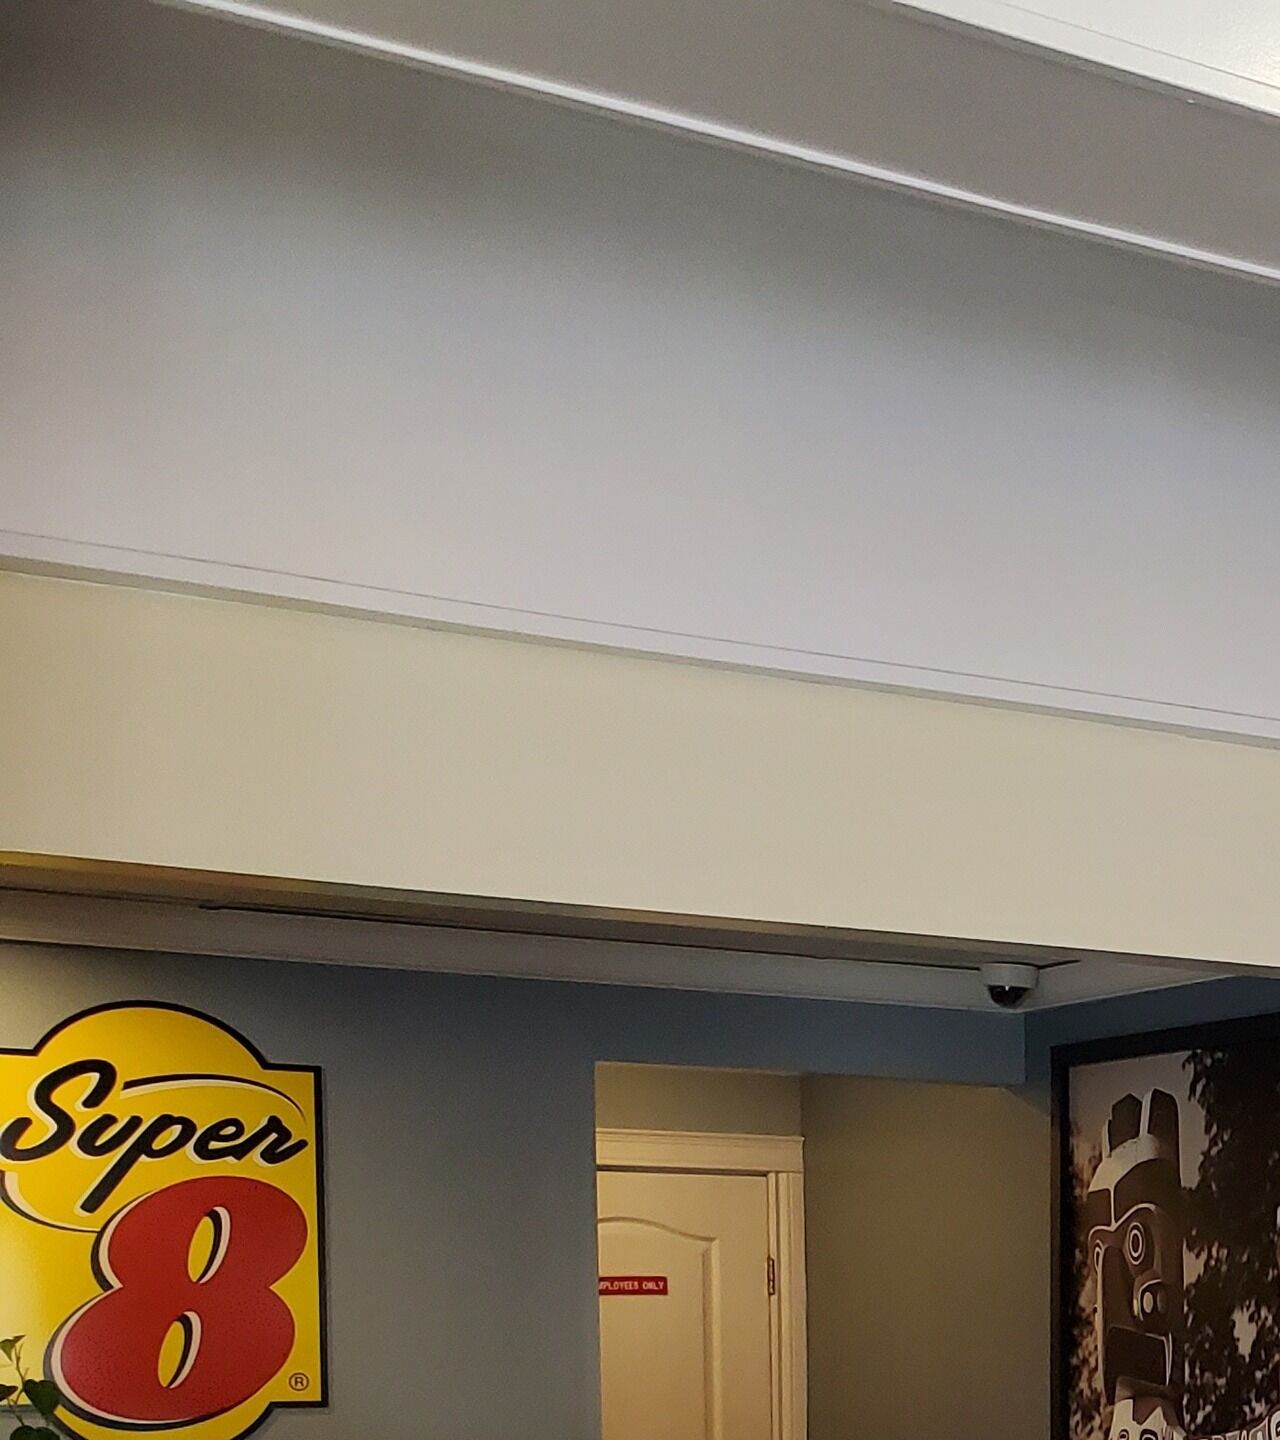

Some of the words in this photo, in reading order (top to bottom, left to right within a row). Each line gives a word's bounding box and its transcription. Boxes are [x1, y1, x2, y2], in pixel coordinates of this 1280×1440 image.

[0, 1059, 309, 1214] Super
[48, 1174, 309, 1427] 8
[642, 1281, 664, 1290] ONLY
